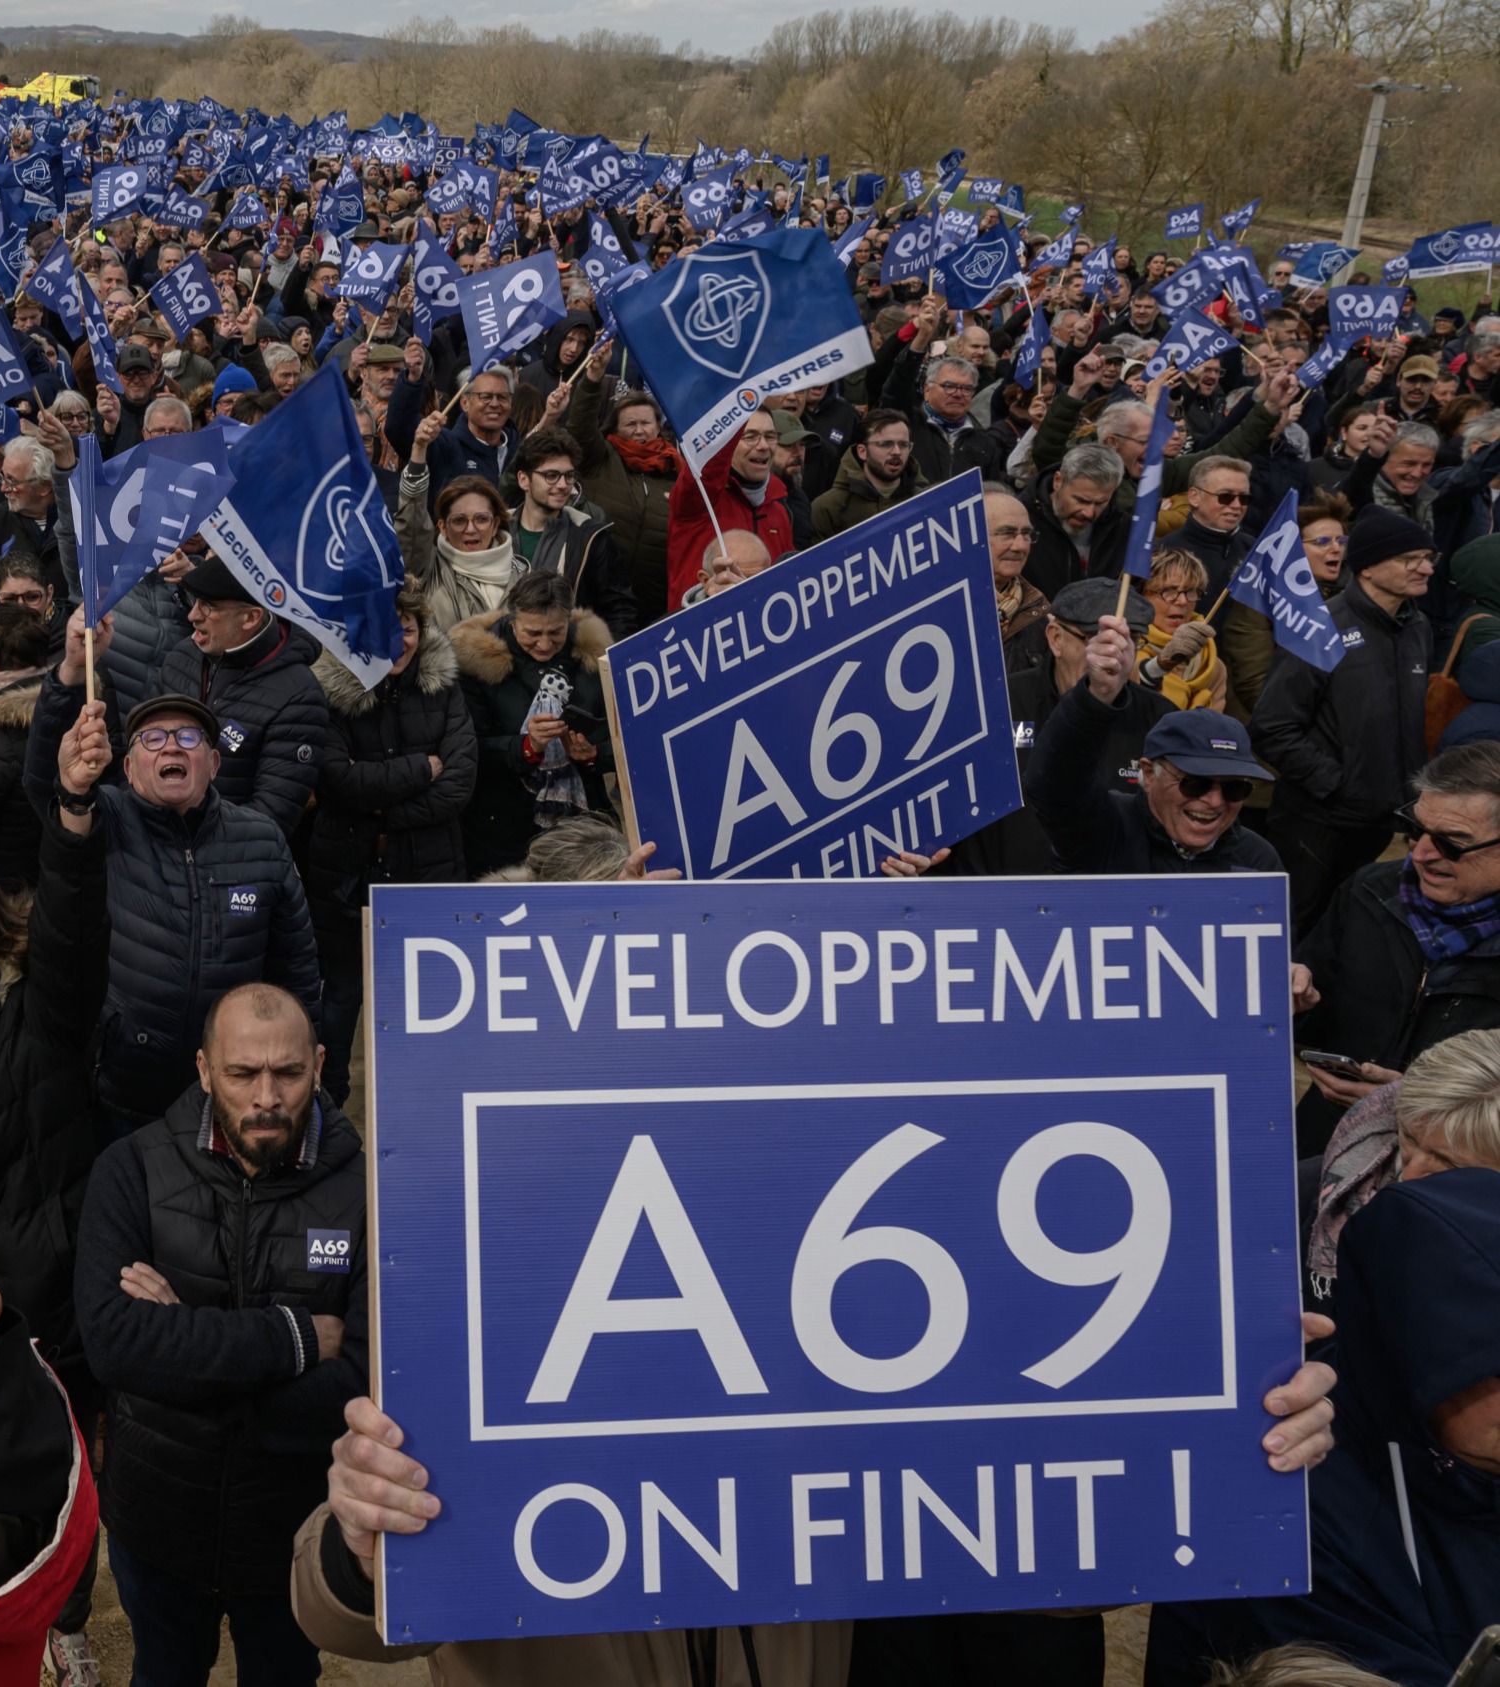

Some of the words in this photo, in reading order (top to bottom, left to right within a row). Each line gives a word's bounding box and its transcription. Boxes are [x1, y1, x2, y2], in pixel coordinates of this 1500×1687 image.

[137, 139, 167, 155] A69
[370, 145, 404, 157] A69
[437, 139, 452, 147] NTÉ
[435, 150, 457, 165] 69
[543, 178, 554, 188] ON
[233, 214, 259, 225] FINIT
[34, 276, 55, 296] ON
[172, 263, 211, 315] A69
[166, 295, 188, 327] FINIT
[693, 406, 742, 453] E.Leclerc
[208, 508, 266, 586] E.Leclerc
[1255, 520, 1320, 598] A6
[625, 493, 983, 718] DÉVELOPPEMENT
[1238, 562, 1267, 593] ON
[1269, 591, 1326, 642] FINIT
[1324, 633, 1340, 651] !
[1342, 631, 1361, 644] A69
[223, 725, 244, 742] A69
[710, 624, 955, 870] A69
[820, 780, 950, 879] FINIT
[965, 763, 980, 816] !
[231, 892, 256, 905] A69
[403, 902, 1283, 1034] DÉVELOPPEMENT
[310, 1239, 349, 1256] A69
[309, 1257, 323, 1265] ON
[324, 1257, 345, 1266] FINIT
[525, 1121, 1172, 1403] A69
[513, 1477, 739, 1599] ON
[791, 1459, 1125, 1585] FINIT
[1171, 1449, 1198, 1567] !
